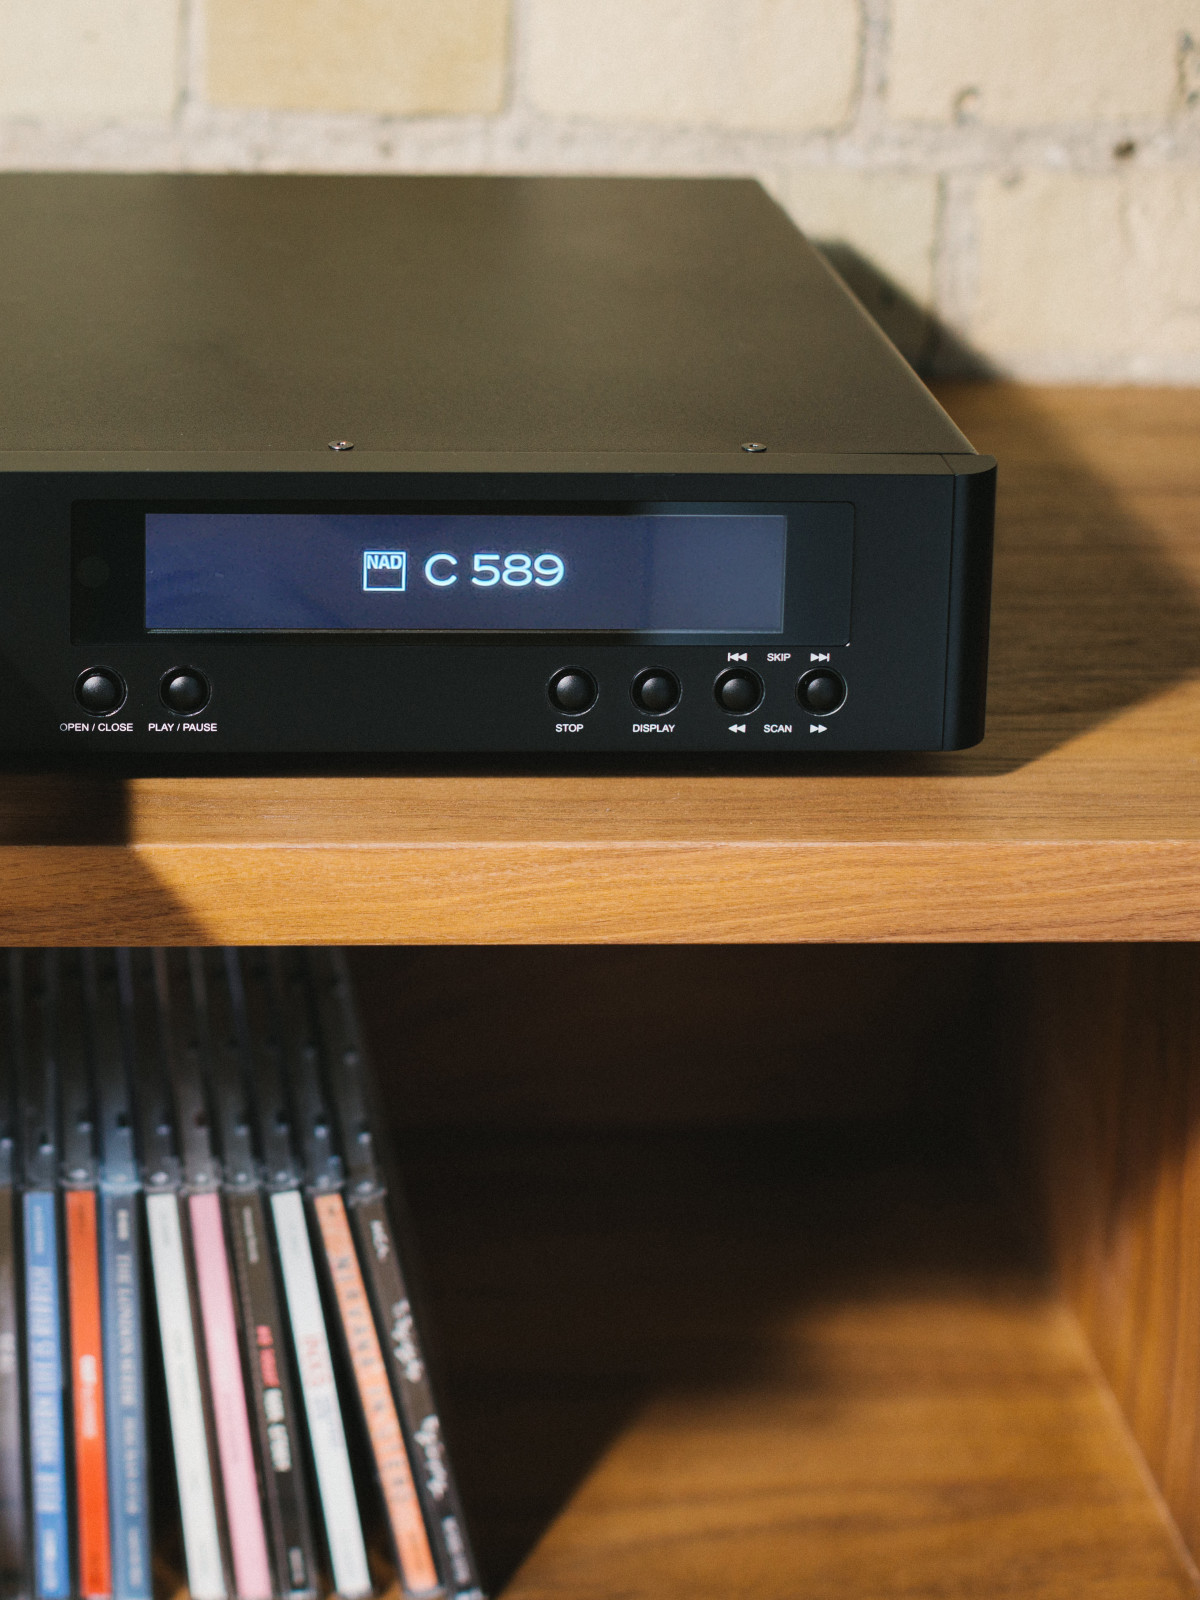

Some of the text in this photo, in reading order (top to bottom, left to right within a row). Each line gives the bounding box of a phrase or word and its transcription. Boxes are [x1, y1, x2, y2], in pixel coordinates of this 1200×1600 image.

[365, 552, 405, 572] NAD
[423, 553, 566, 588] C 589
[766, 652, 792, 662] SKIP
[59, 722, 90, 732] OPEN
[97, 722, 134, 732] CLOSE
[147, 722, 175, 732] PLAY
[182, 722, 218, 732] PAUSE
[555, 723, 584, 733] STOP
[632, 723, 676, 733] DISPLAY
[763, 723, 793, 734] SCAN
